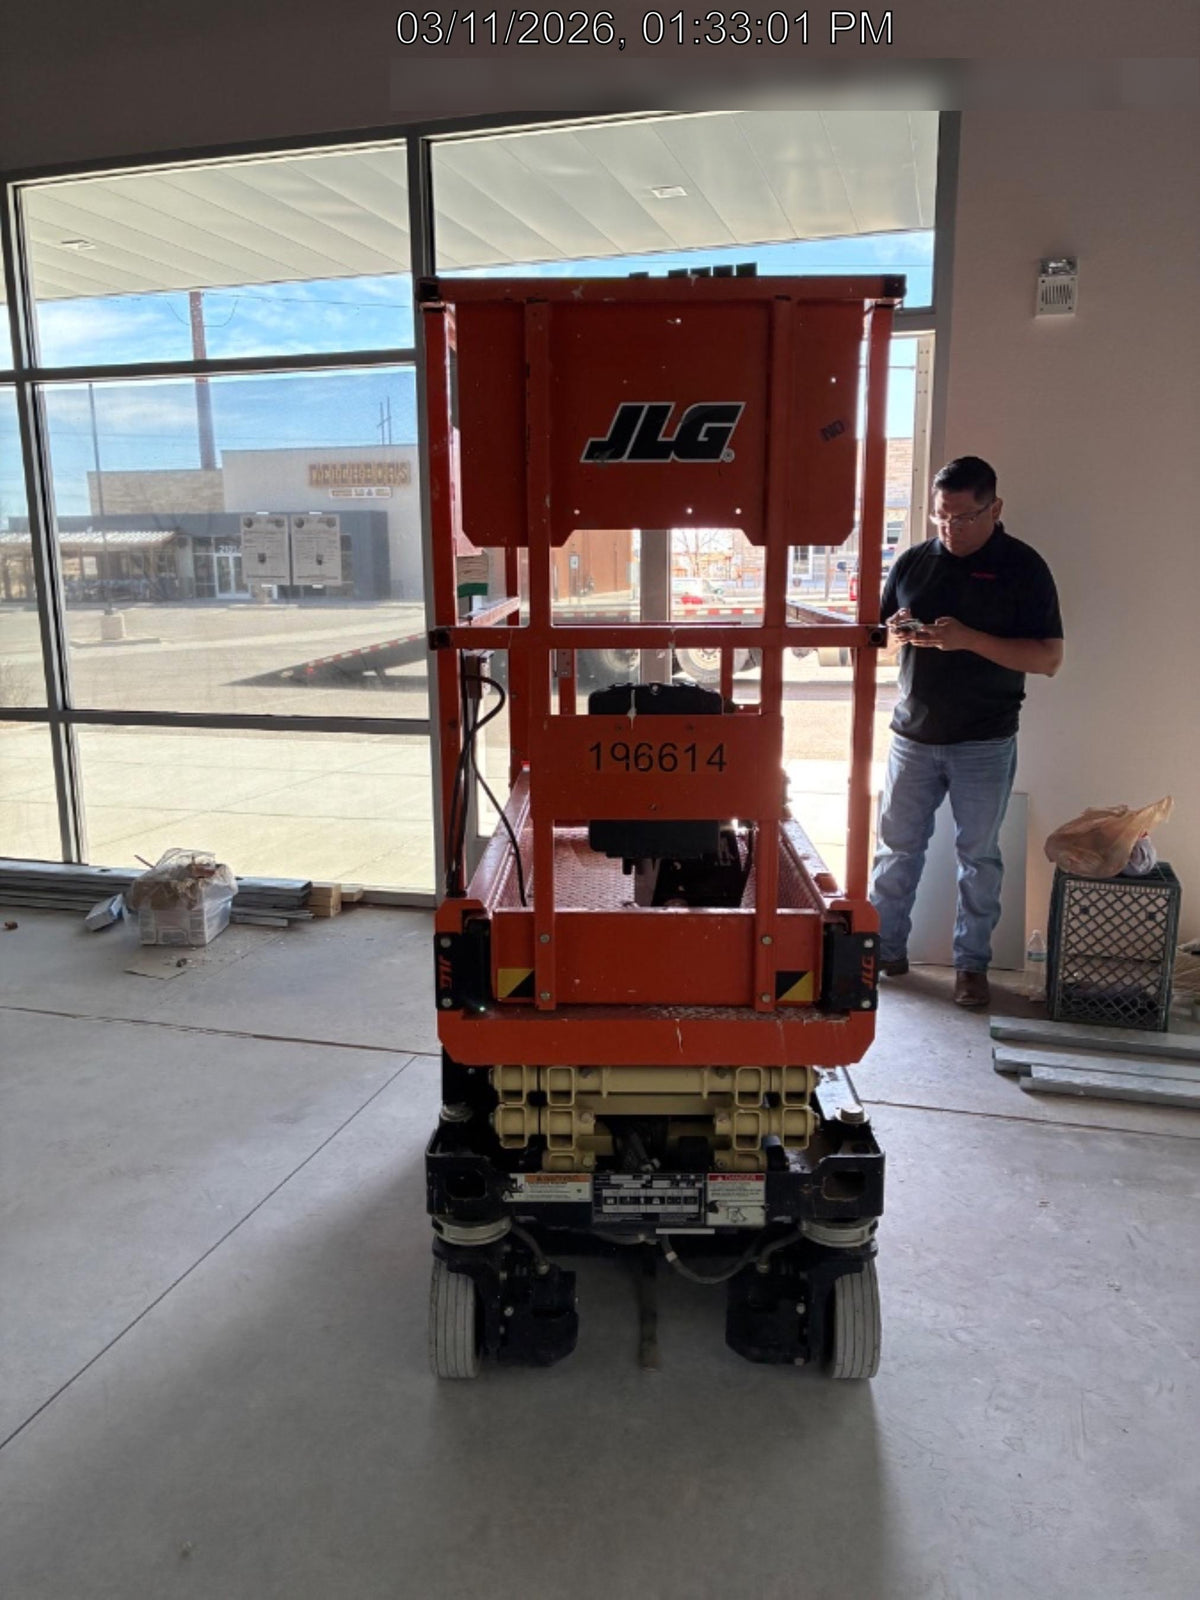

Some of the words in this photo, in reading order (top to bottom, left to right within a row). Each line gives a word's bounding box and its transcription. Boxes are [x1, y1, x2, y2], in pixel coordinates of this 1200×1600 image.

[580, 401, 746, 463] JLG
[589, 741, 727, 773] 196614
[438, 954, 452, 990] JLG
[861, 954, 875, 991] JLG
